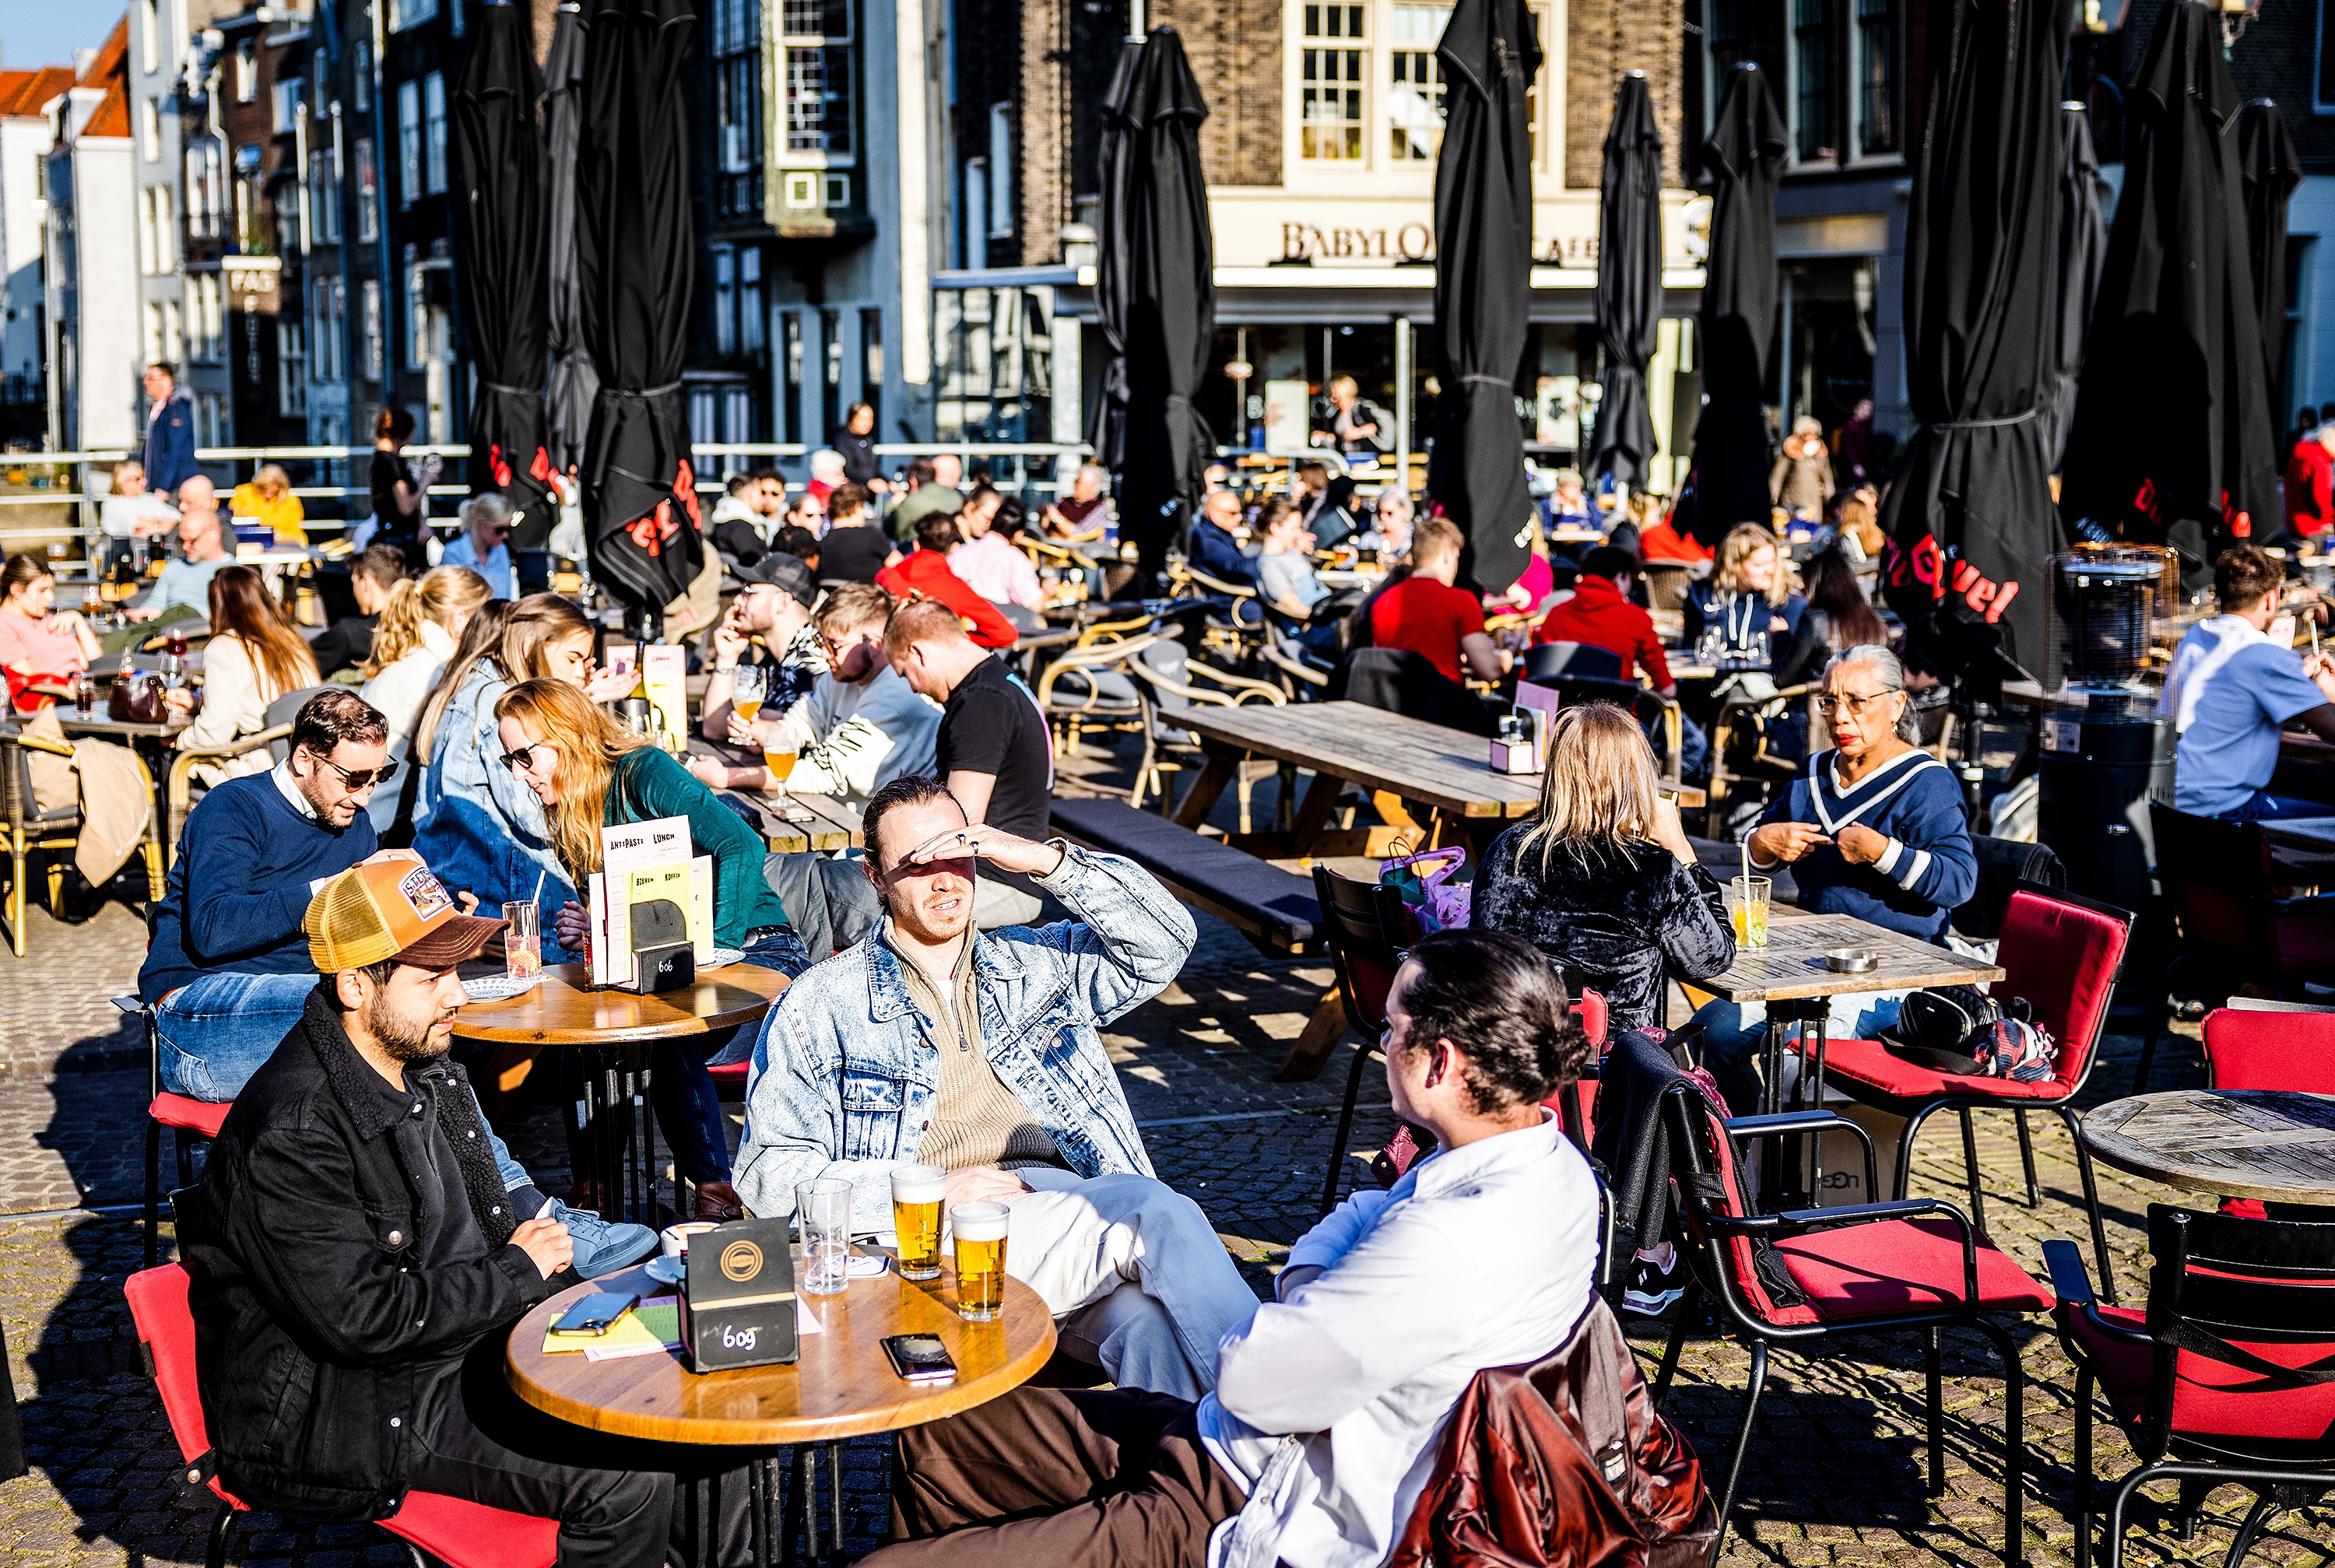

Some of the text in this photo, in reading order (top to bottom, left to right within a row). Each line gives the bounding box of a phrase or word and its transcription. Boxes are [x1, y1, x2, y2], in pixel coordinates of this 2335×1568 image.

[1283, 223, 1599, 259] BABYLO AFE
[610, 833, 675, 851] ANTIPASTI LUNCH
[636, 877, 654, 886] BIEREN
[658, 959, 673, 973] 606
[1822, 1171, 1859, 1189] UGG
[723, 1324, 757, 1350] 609
